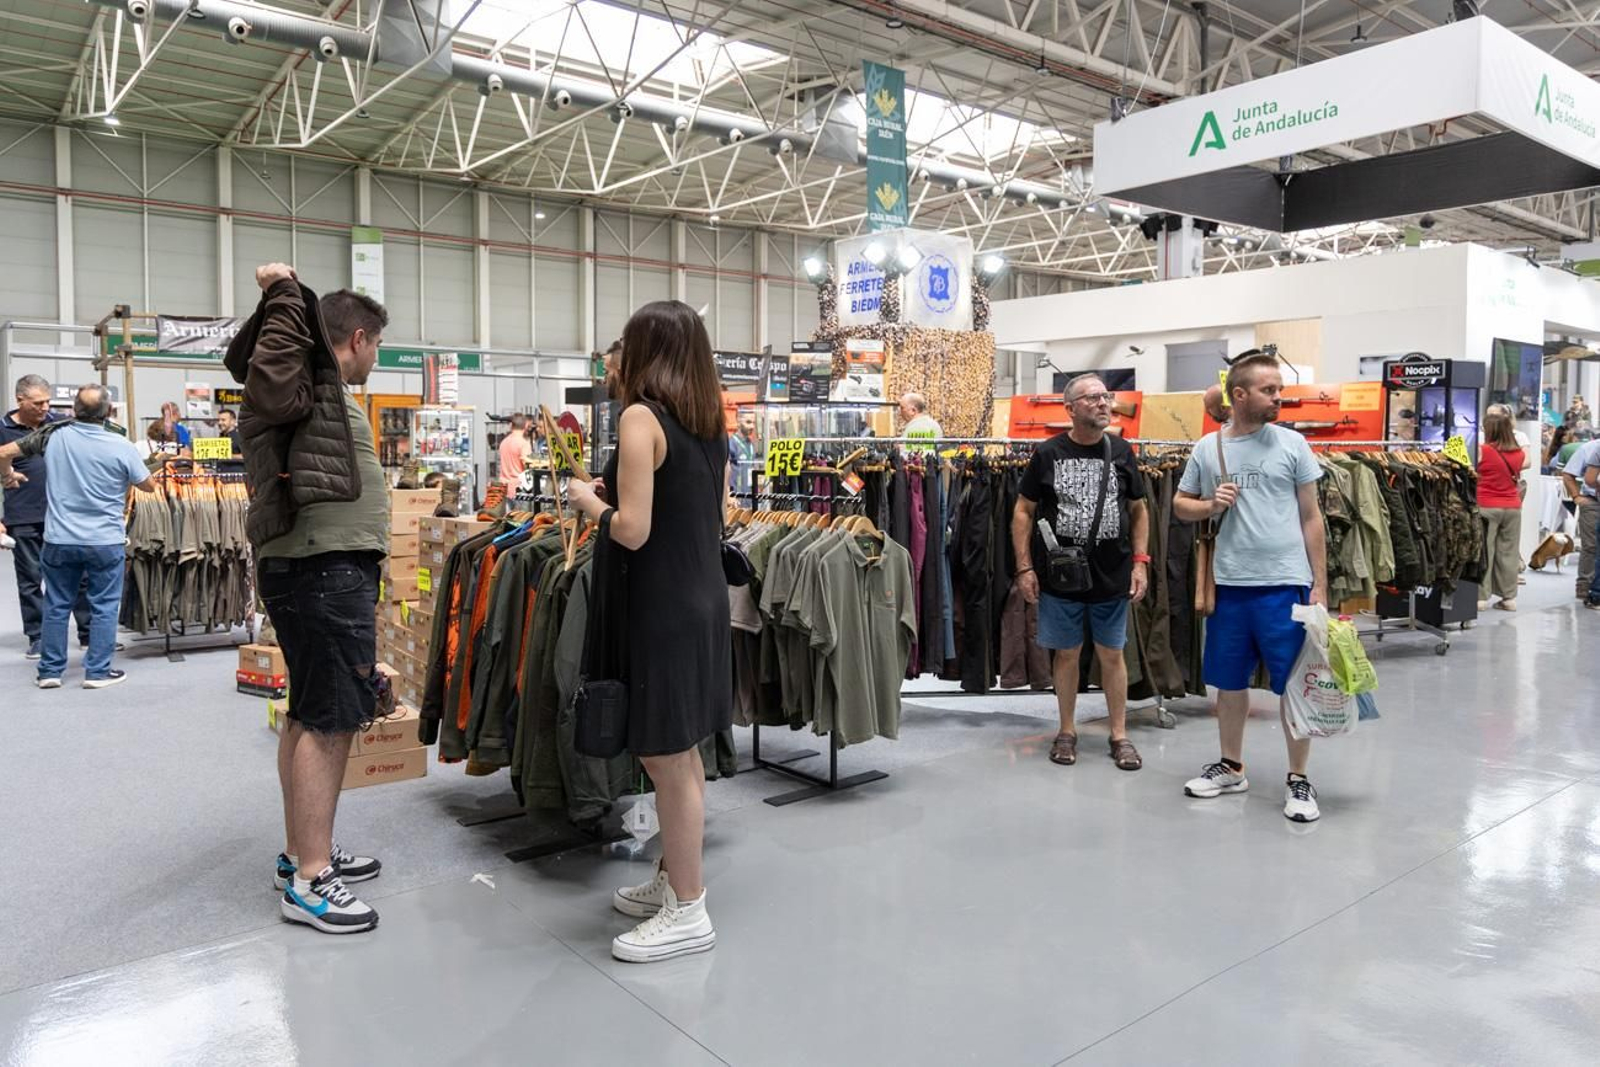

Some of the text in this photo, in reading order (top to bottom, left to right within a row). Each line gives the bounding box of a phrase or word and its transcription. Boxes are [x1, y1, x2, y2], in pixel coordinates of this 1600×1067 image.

[1233, 101, 1278, 123] Junta
[1232, 101, 1338, 141] de Andalucía
[840, 277, 884, 296] FERRETE
[851, 298, 883, 314] BIEDM
[1405, 364, 1440, 377] Nocpix
[770, 440, 803, 452] POLO
[768, 452, 801, 473] 15€
[1415, 585, 1434, 599] ay
